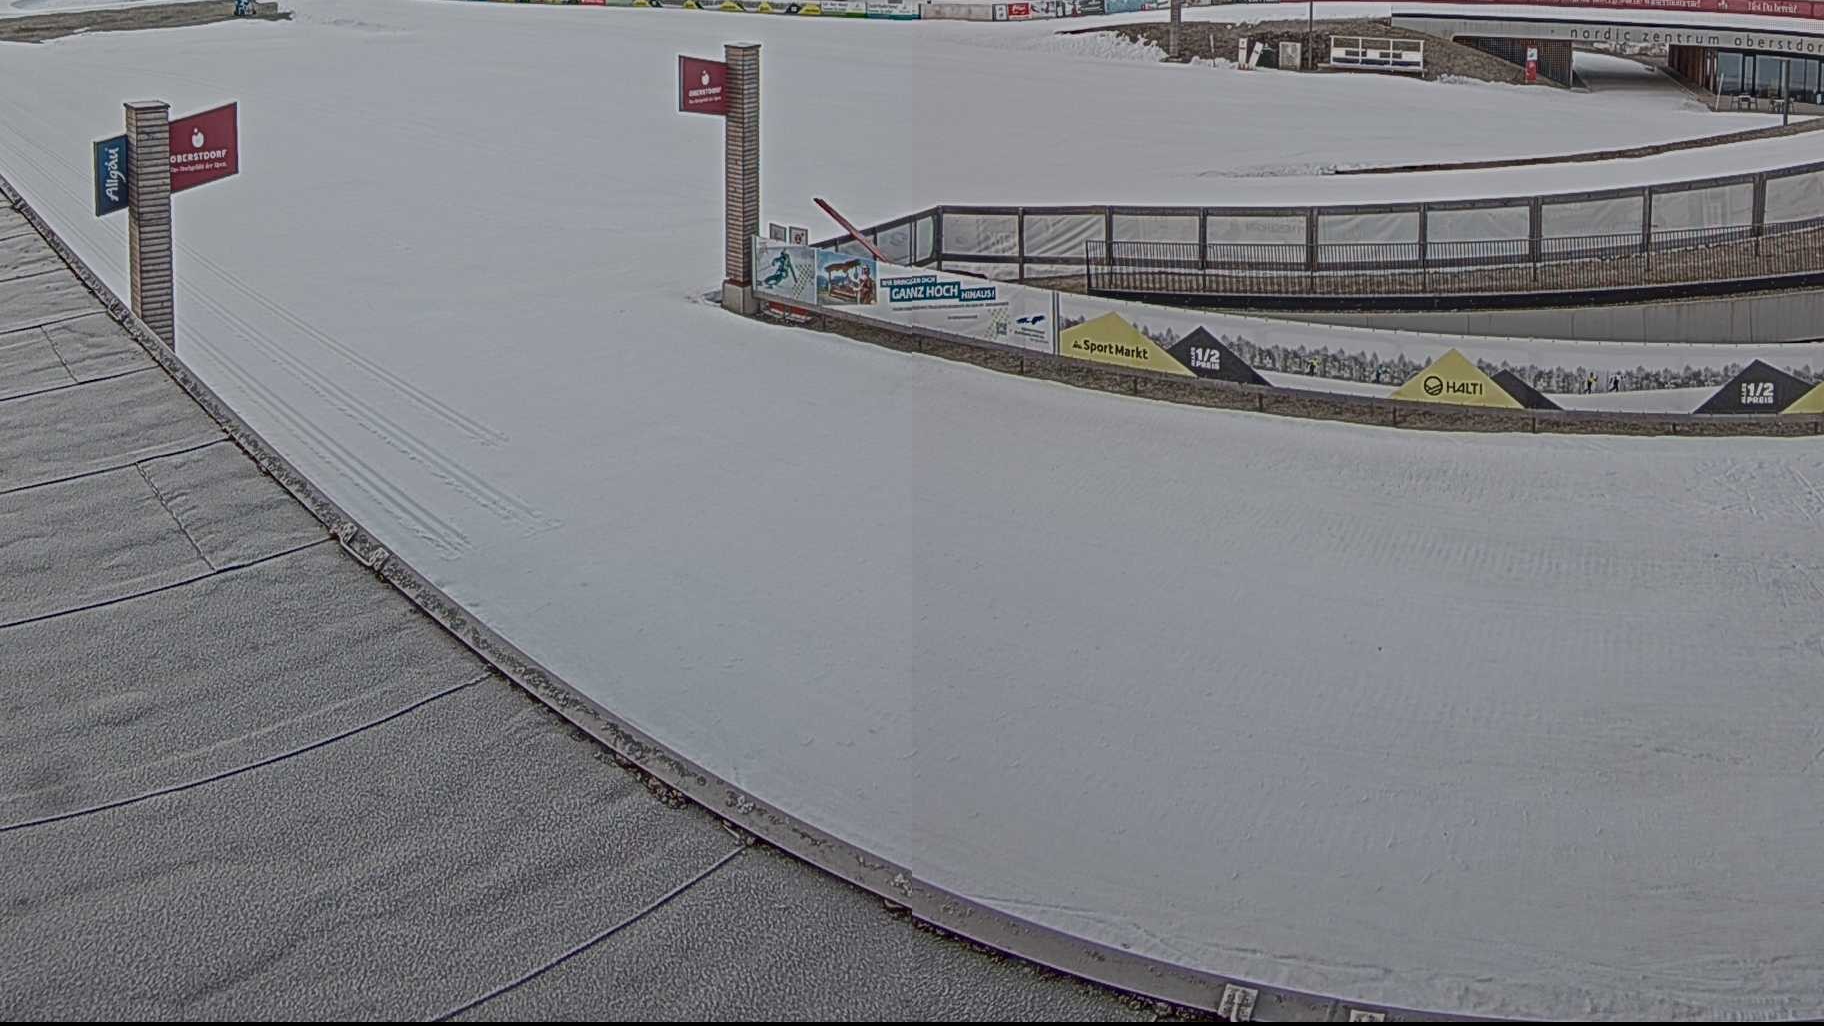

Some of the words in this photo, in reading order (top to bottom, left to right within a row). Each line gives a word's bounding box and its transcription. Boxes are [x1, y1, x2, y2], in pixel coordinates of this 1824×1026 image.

[1570, 28, 1631, 40] nordic
[1643, 32, 1720, 45] zentrum
[170, 149, 227, 163] OBERSTDORF
[926, 285, 958, 297] HOCH
[1446, 381, 1483, 395] HALTI
